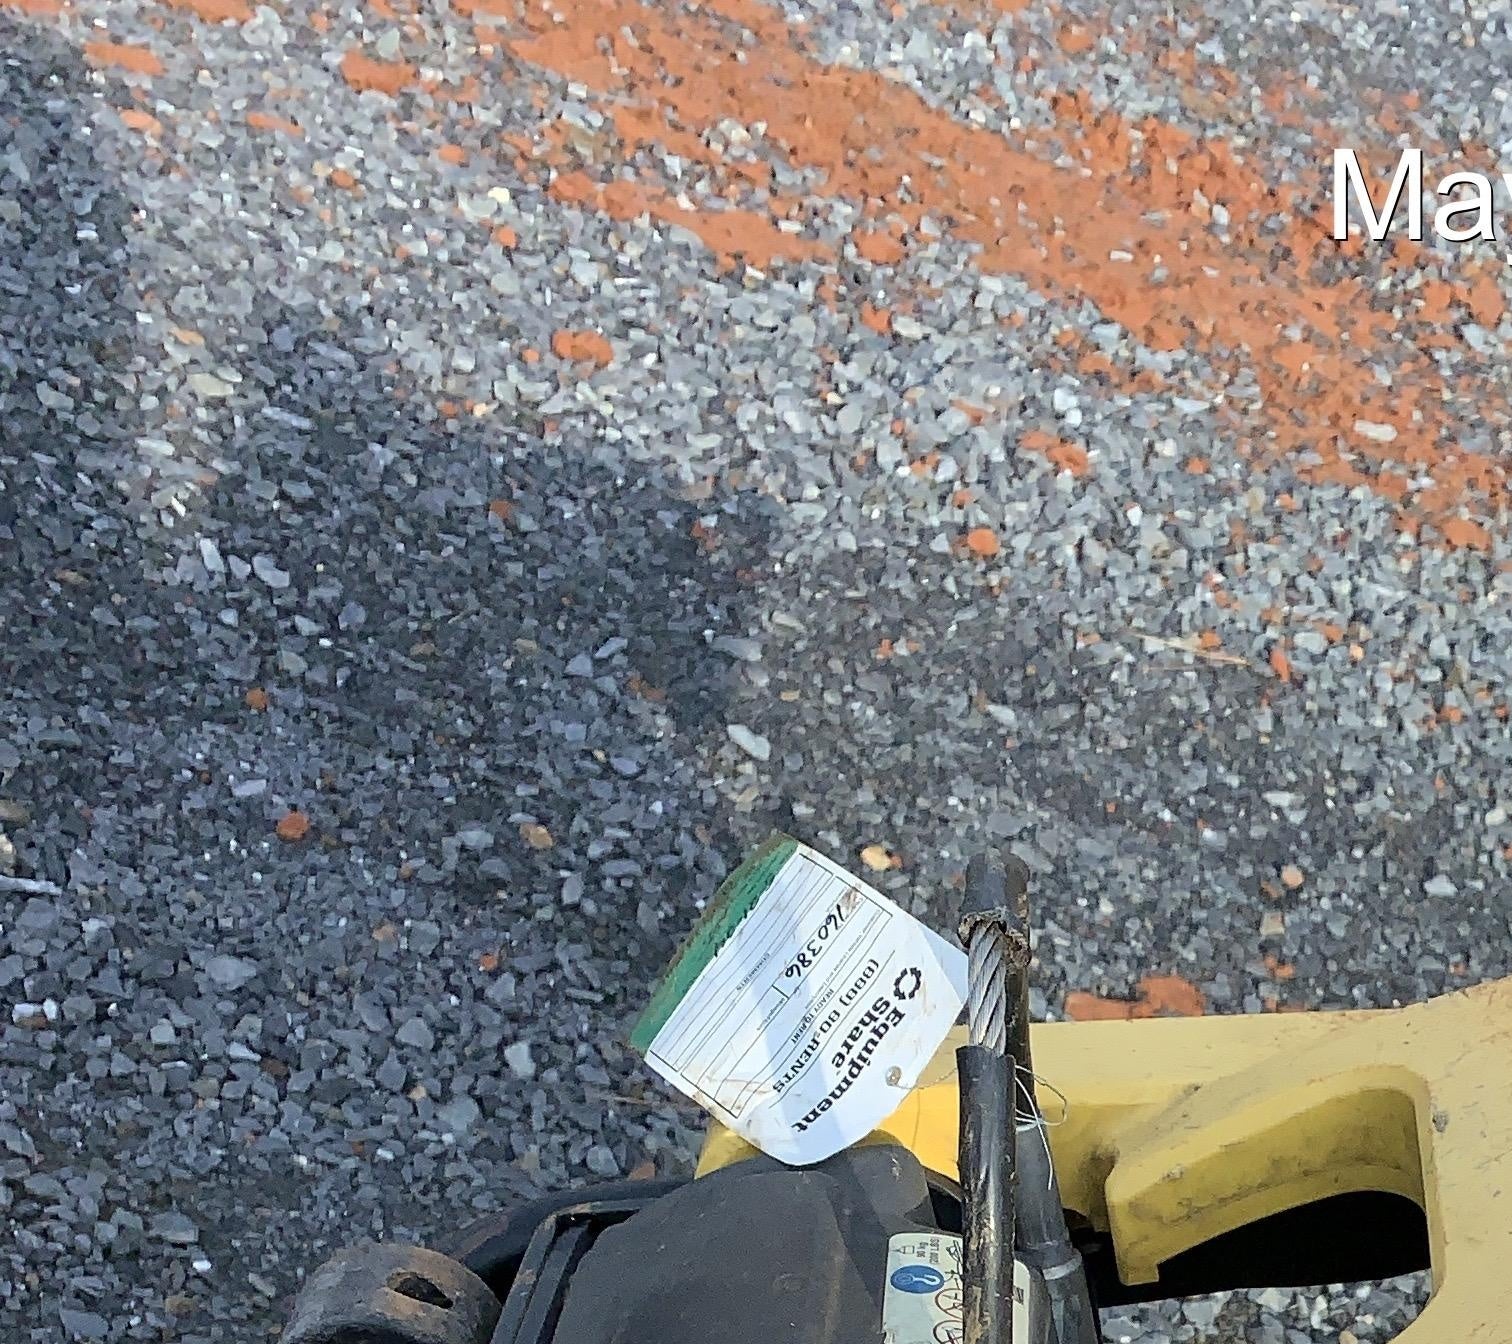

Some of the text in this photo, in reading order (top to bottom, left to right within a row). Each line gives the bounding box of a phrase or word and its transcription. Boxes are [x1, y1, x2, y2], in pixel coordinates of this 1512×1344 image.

[784, 903, 848, 979] 160386
[840, 958, 879, 1007] (888)
[791, 1006, 906, 1133] Equipment
[832, 996, 891, 1069] Share
